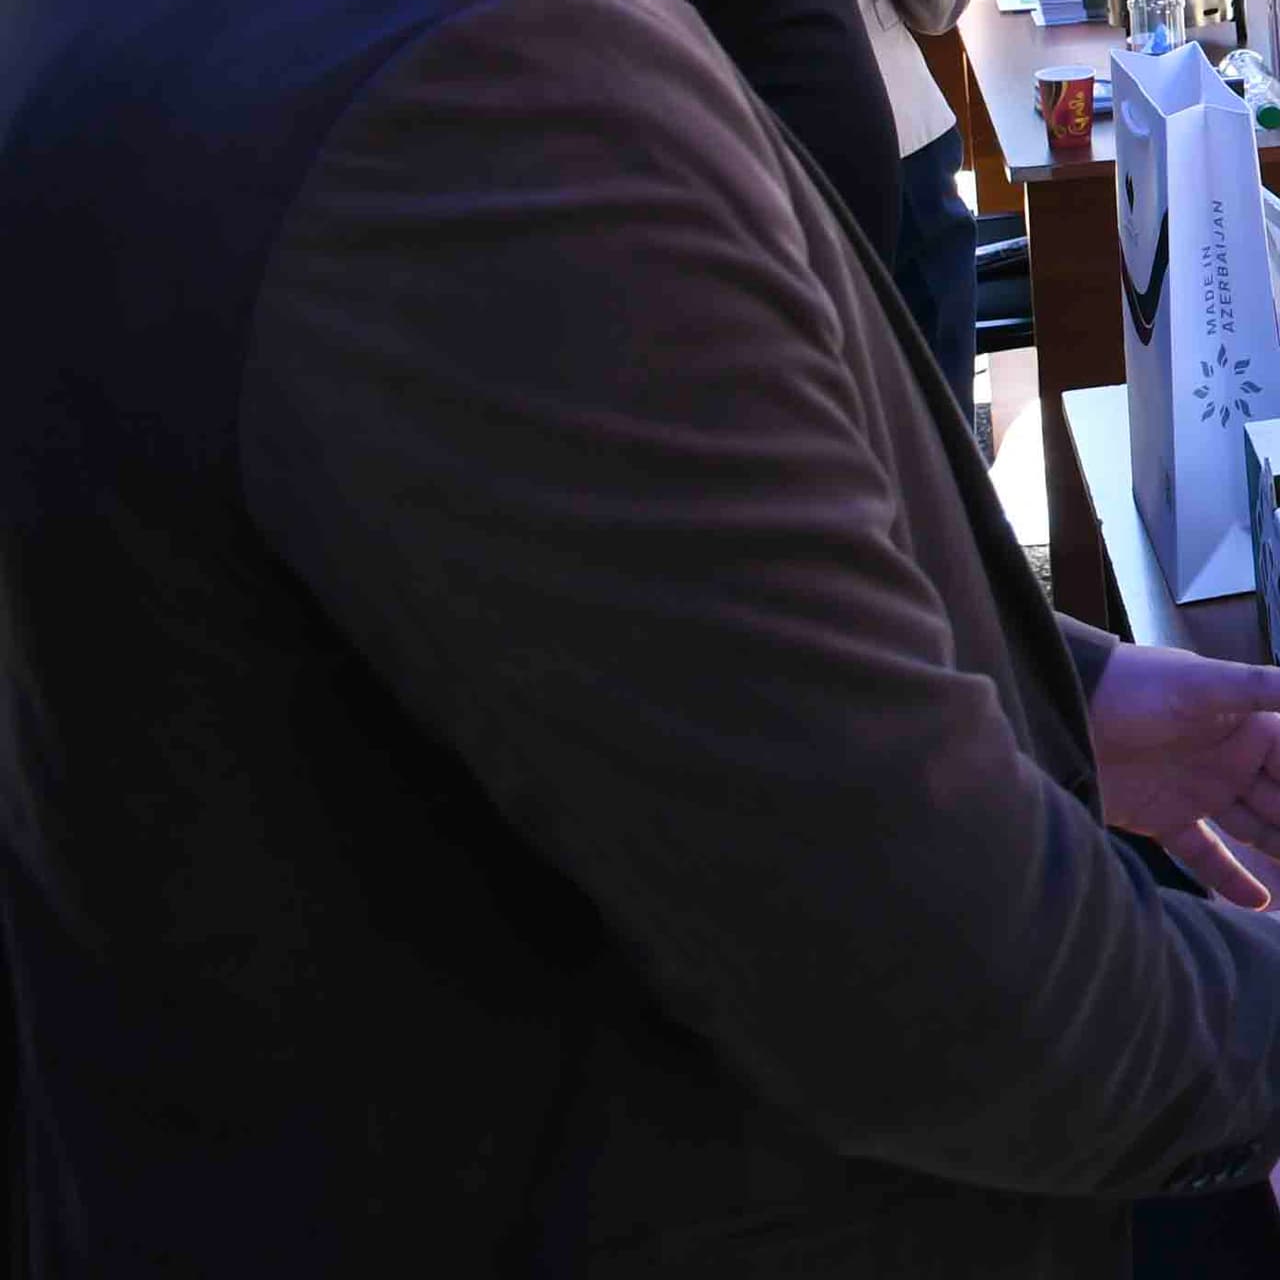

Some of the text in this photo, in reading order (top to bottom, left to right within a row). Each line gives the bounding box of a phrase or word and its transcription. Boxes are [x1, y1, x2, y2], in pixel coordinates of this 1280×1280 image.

[1201, 245, 1217, 336] MADE IN
[1211, 200, 1235, 334] AZERBAIJAN
